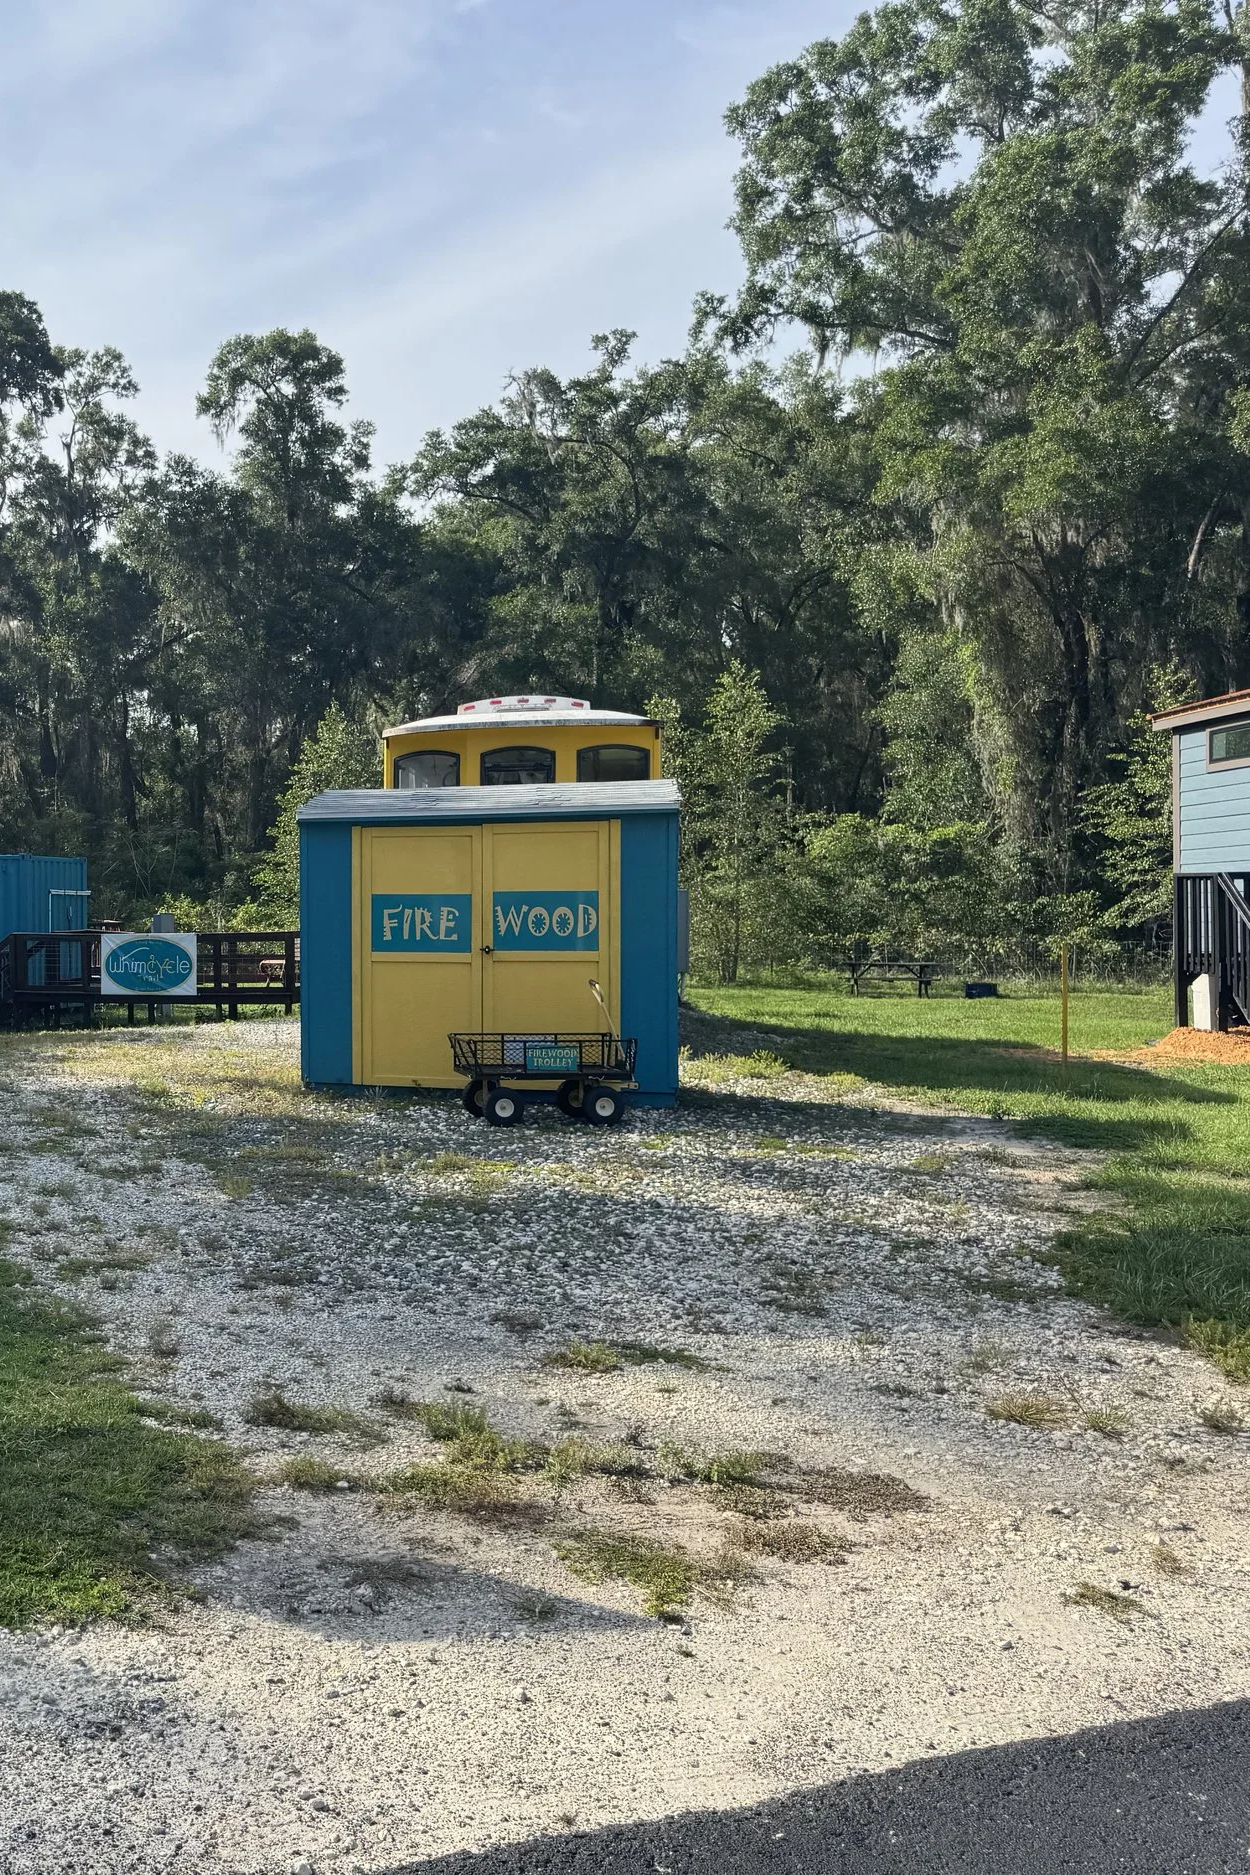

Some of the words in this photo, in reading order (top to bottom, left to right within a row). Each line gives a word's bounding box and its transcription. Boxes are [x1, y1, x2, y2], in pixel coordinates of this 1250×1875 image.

[383, 904, 459, 941] FIRE
[495, 904, 597, 938] WOOD
[528, 1048, 577, 1058] FIREWOOD
[533, 1058, 573, 1067] TROLLEY
